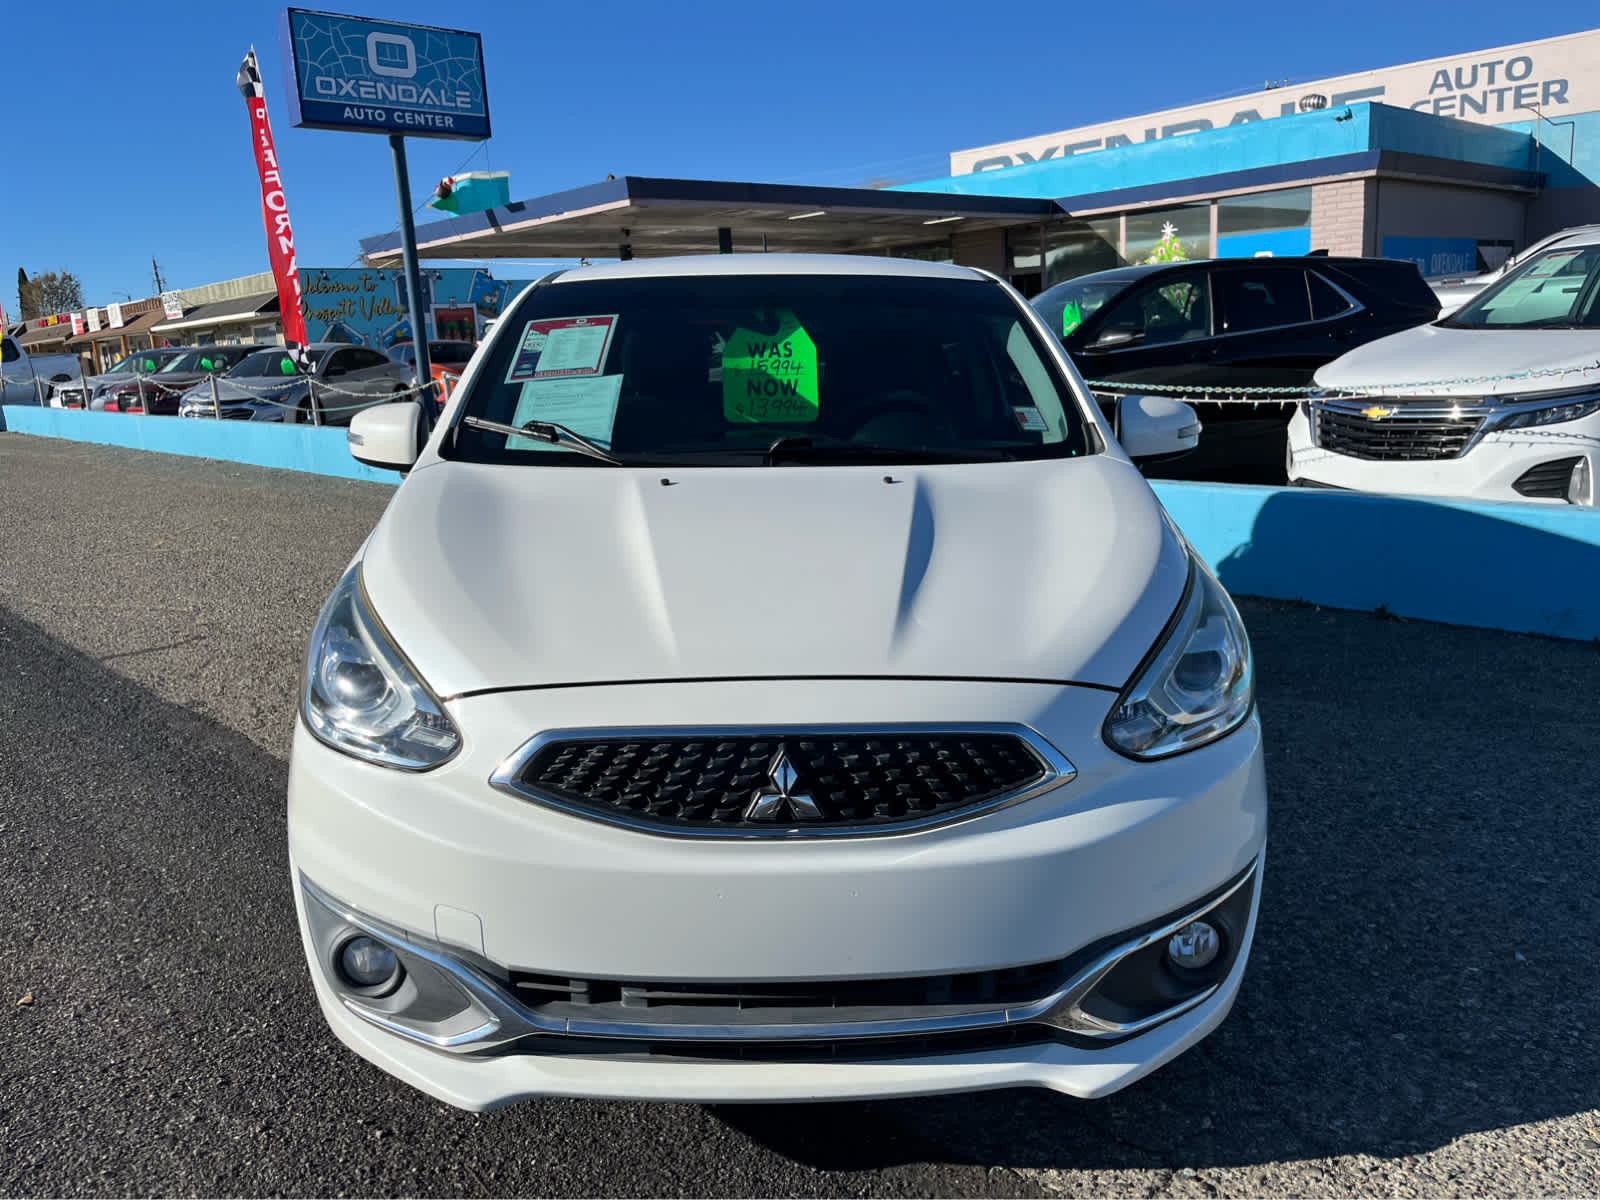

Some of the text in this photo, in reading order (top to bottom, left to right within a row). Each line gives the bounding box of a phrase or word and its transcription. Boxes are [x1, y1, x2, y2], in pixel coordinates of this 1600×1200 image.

[1429, 56, 1533, 95] AUTO
[315, 75, 472, 109] OXENDALE
[344, 107, 454, 128] AUTO CENTER
[359, 272, 379, 292] to
[747, 341, 794, 359] WAS
[747, 377, 799, 397] NOW
